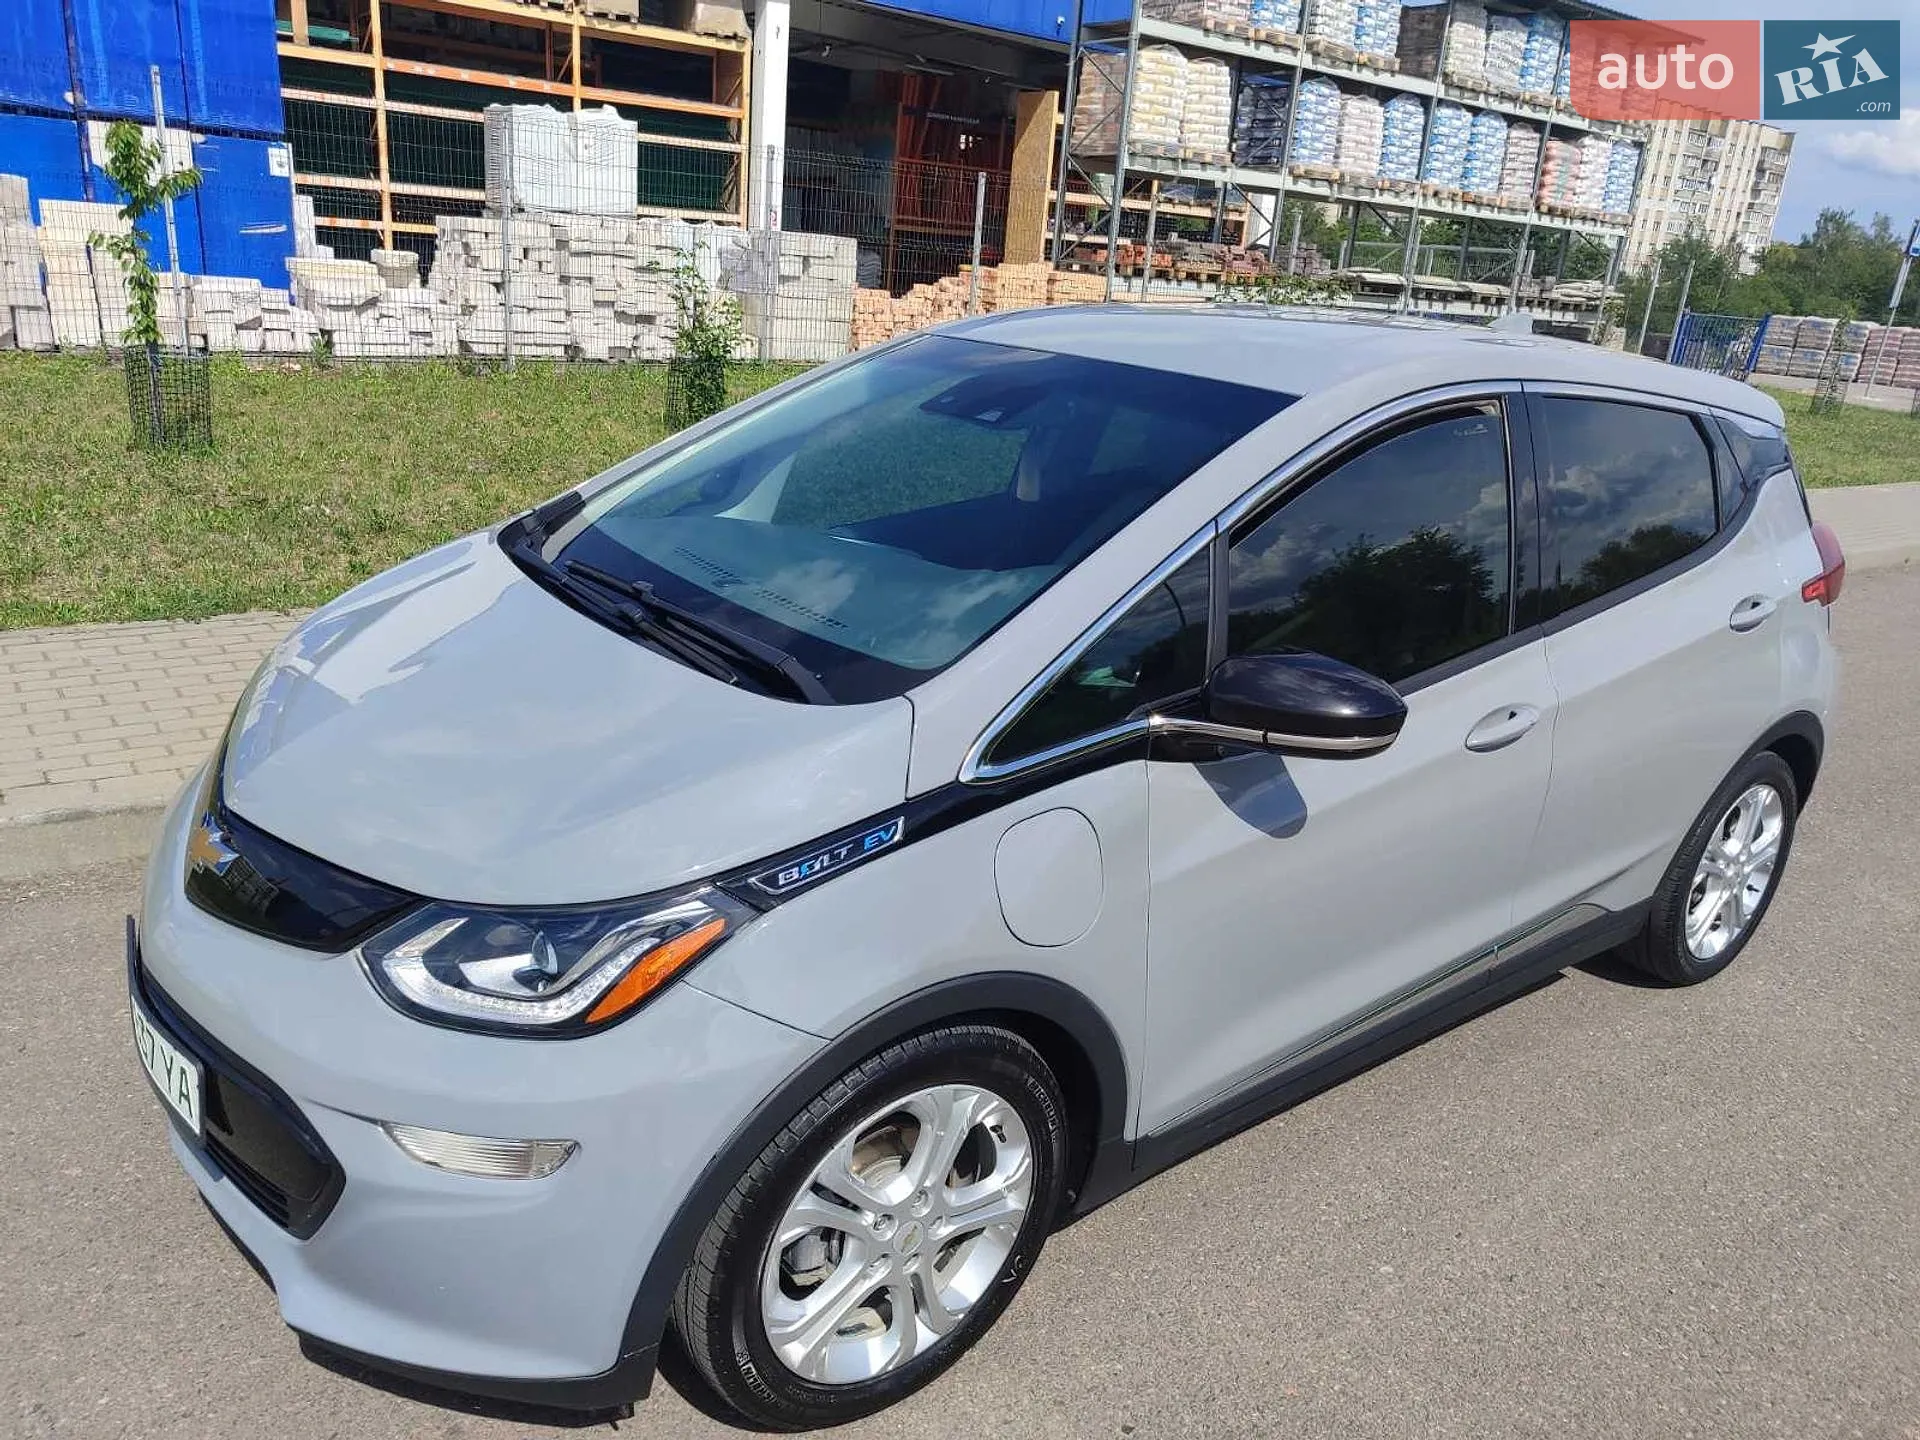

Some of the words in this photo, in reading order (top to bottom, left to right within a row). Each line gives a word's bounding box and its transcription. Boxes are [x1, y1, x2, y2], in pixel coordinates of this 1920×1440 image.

[778, 844, 854, 886] BOLT
[863, 825, 896, 851] EV
[160, 1045, 194, 1119] YA
